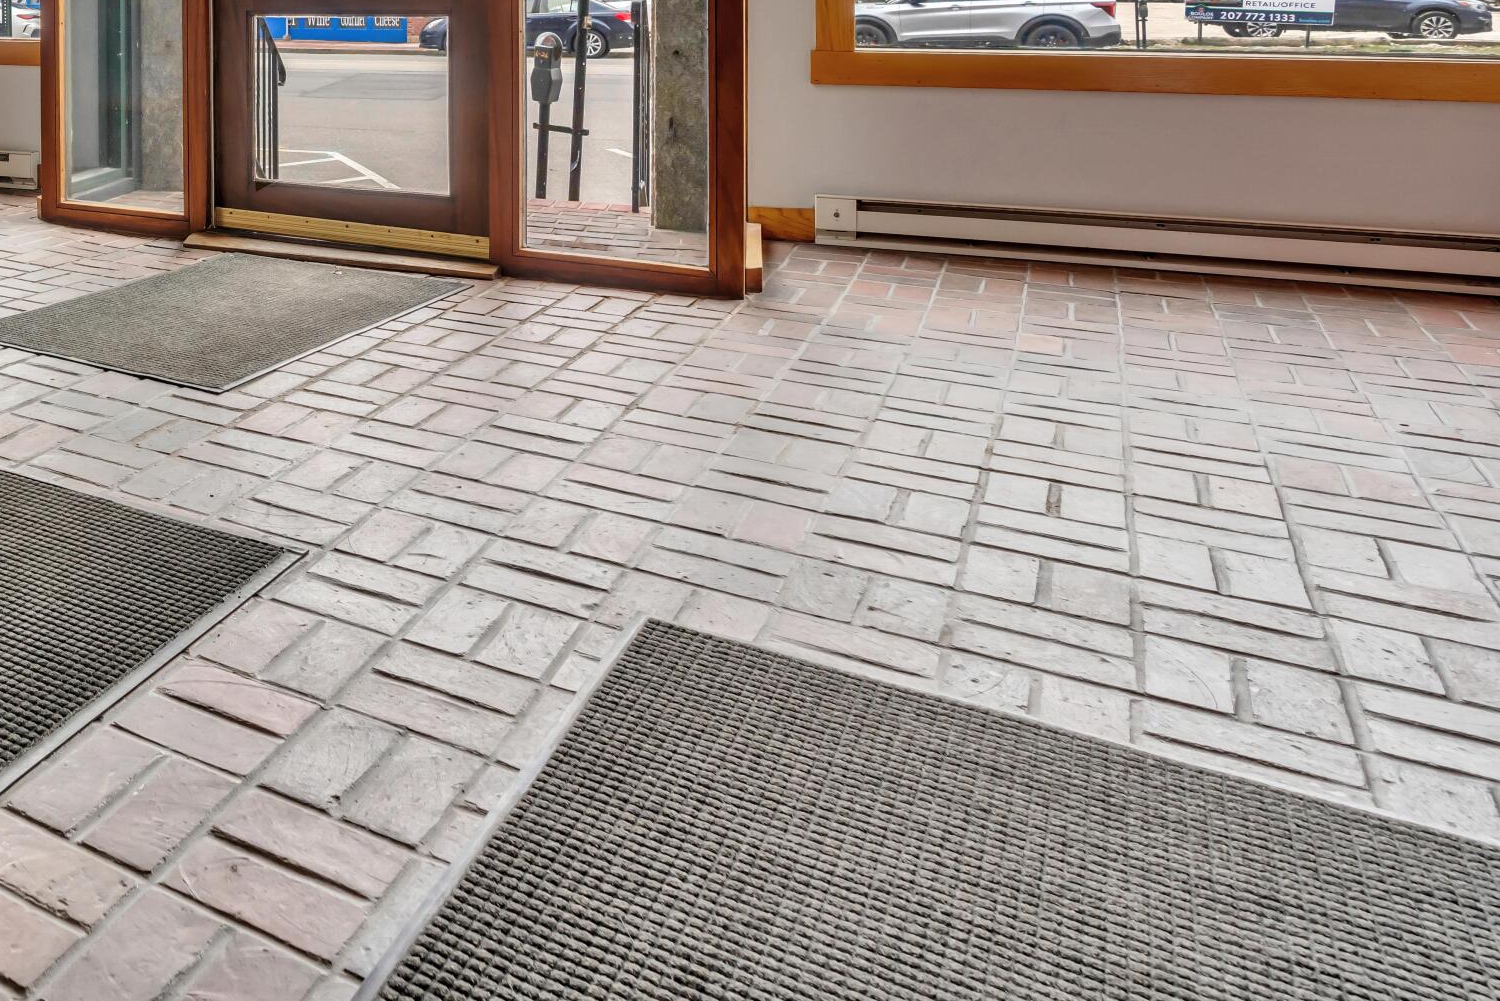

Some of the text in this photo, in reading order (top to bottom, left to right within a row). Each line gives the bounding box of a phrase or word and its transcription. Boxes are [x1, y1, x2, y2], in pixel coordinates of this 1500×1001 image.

[1245, 0, 1316, 9] RETAIL/OFFICE
[1220, 11, 1243, 20] 207
[1245, 12, 1266, 21] 772
[1269, 13, 1296, 22] 1333
